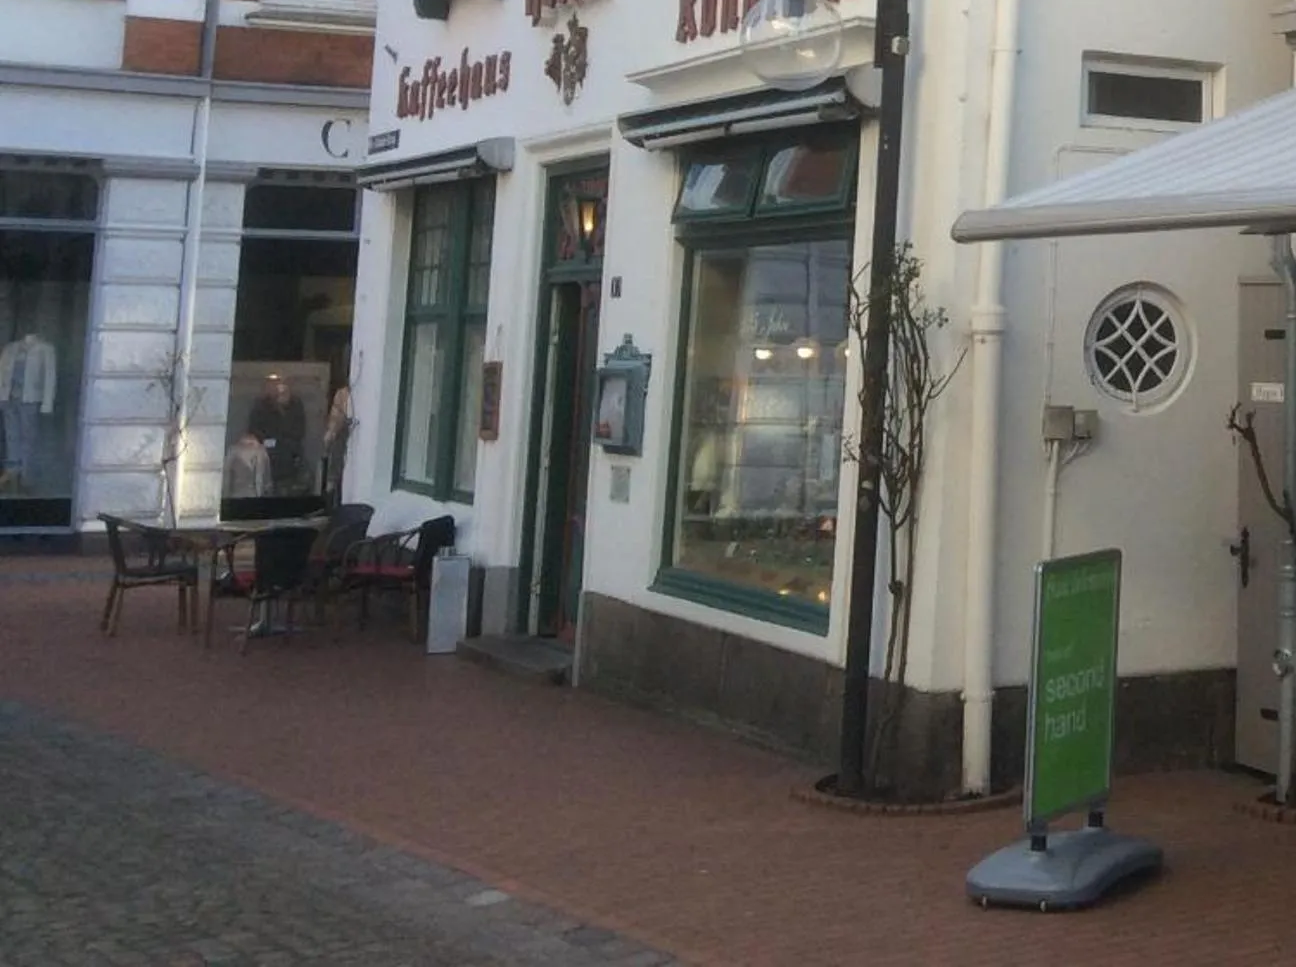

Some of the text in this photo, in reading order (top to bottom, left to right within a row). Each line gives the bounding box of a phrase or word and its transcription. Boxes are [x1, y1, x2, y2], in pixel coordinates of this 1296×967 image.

[396, 45, 512, 122] Kaffeehaus
[1044, 656, 1105, 704] second
[1044, 694, 1087, 744] hand
